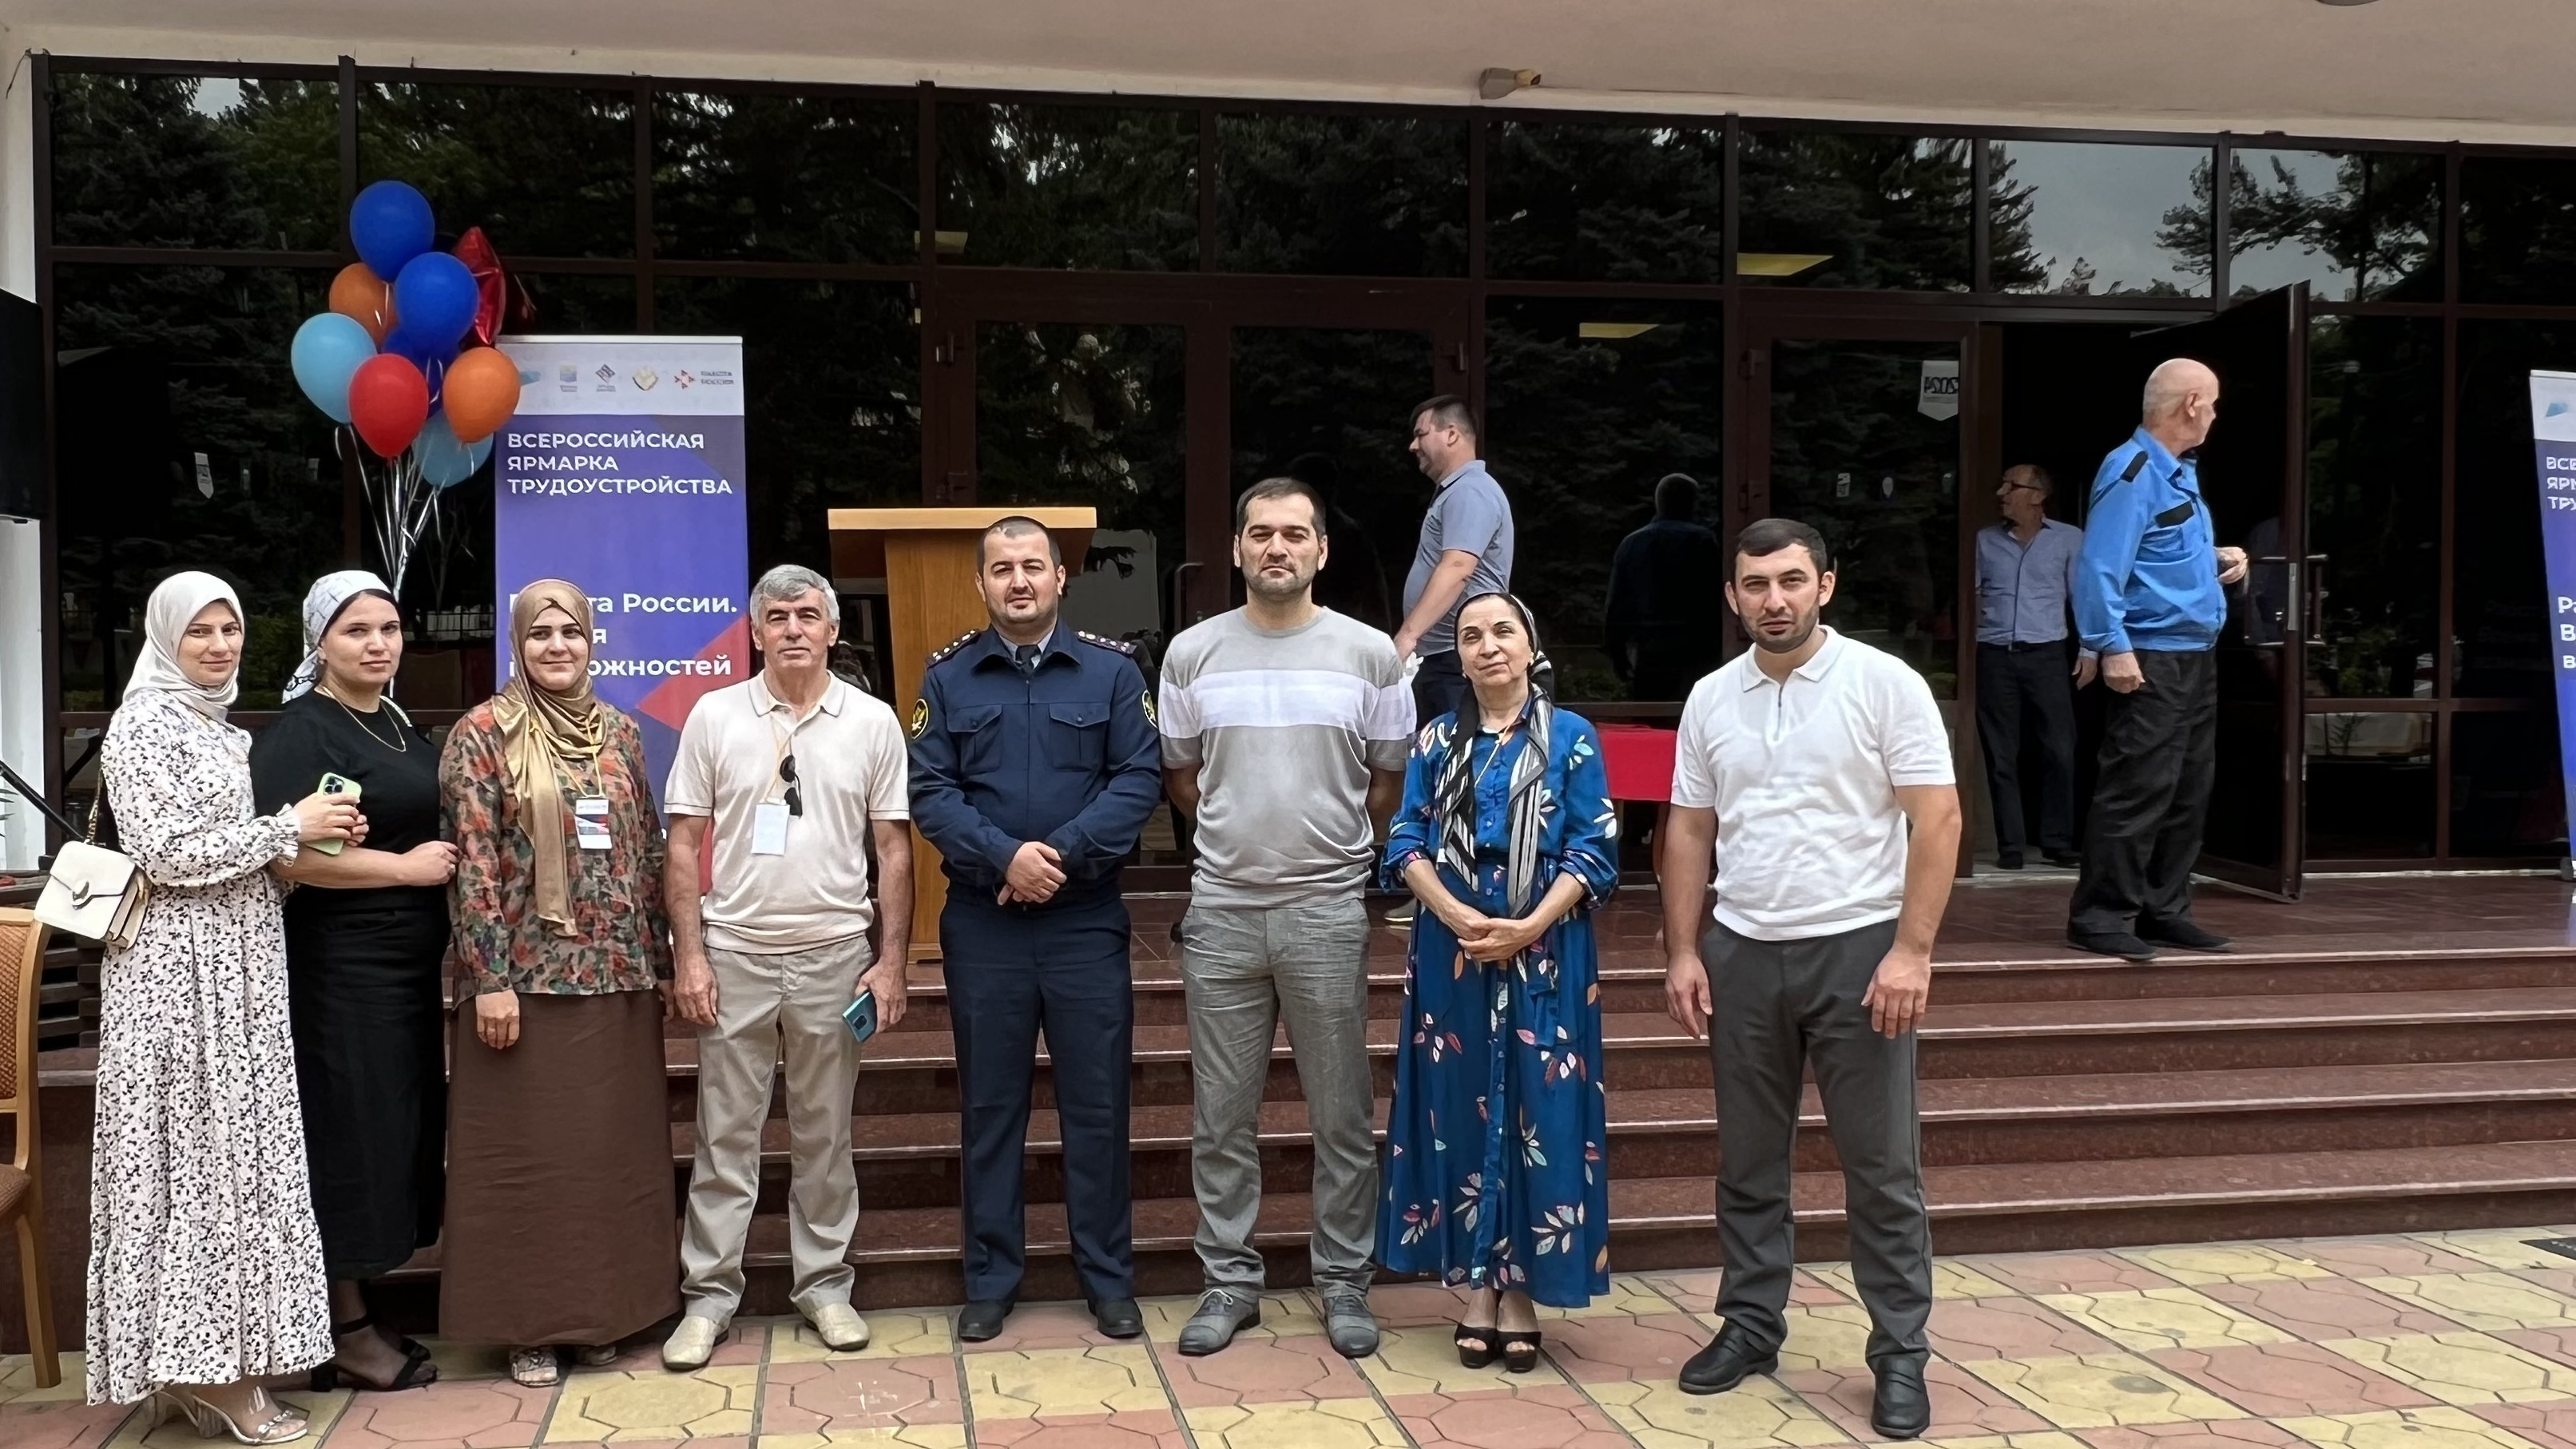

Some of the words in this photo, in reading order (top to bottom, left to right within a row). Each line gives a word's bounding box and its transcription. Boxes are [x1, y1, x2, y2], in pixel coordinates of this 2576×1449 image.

[508, 430, 705, 449] ВСЕРОССИЙСКАЯ
[507, 455, 619, 471] ЯРМАРКА
[507, 476, 733, 496] ТРУДОУСТРОЙСТВА
[623, 593, 738, 613] России.
[2558, 596, 2576, 613] Р
[510, 655, 732, 676] ожностей
